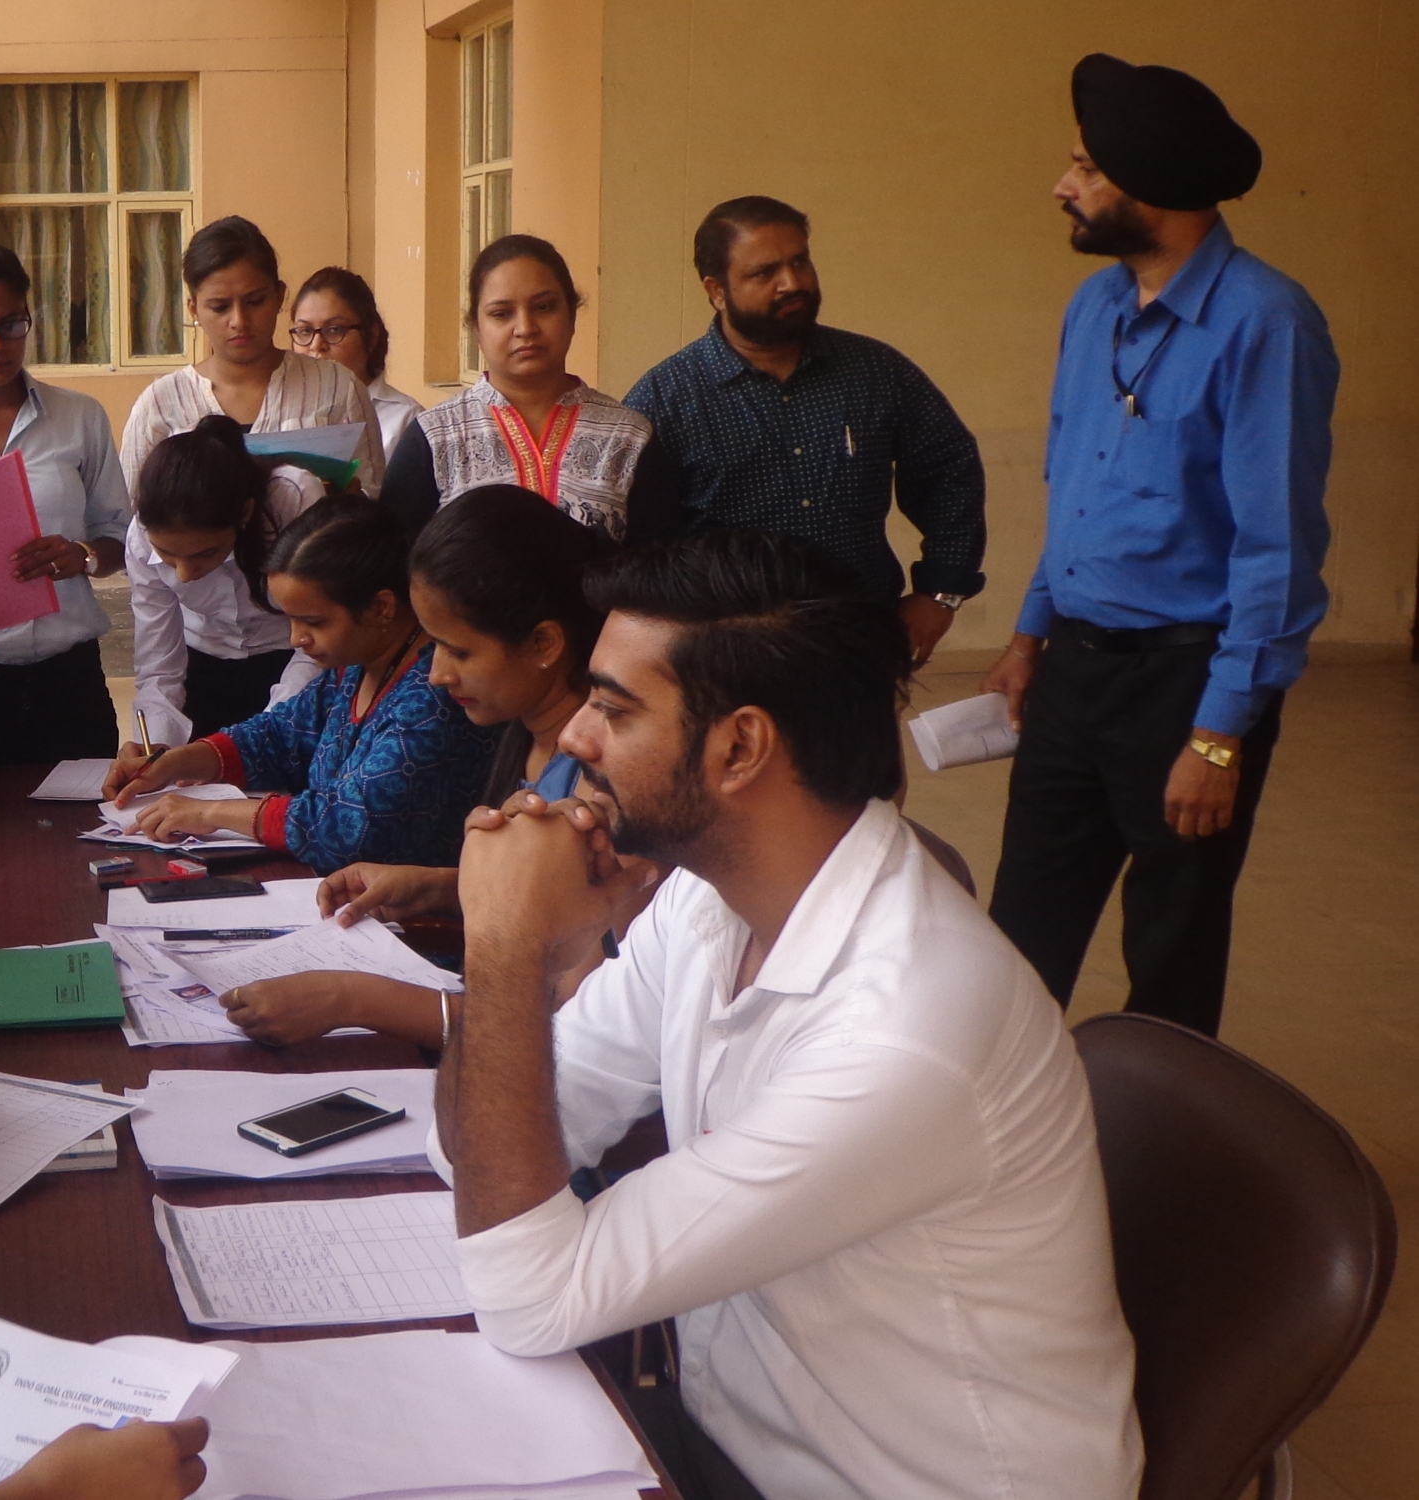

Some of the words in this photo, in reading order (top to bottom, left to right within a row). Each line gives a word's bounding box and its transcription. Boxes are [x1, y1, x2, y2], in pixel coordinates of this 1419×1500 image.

[15, 1376, 35, 1390] INDO
[35, 1382, 62, 1398] GLOBAL
[61, 1388, 92, 1404] COLLEGE
[92, 1395, 104, 1406] OF
[103, 1397, 153, 1418] ENGINEERING
